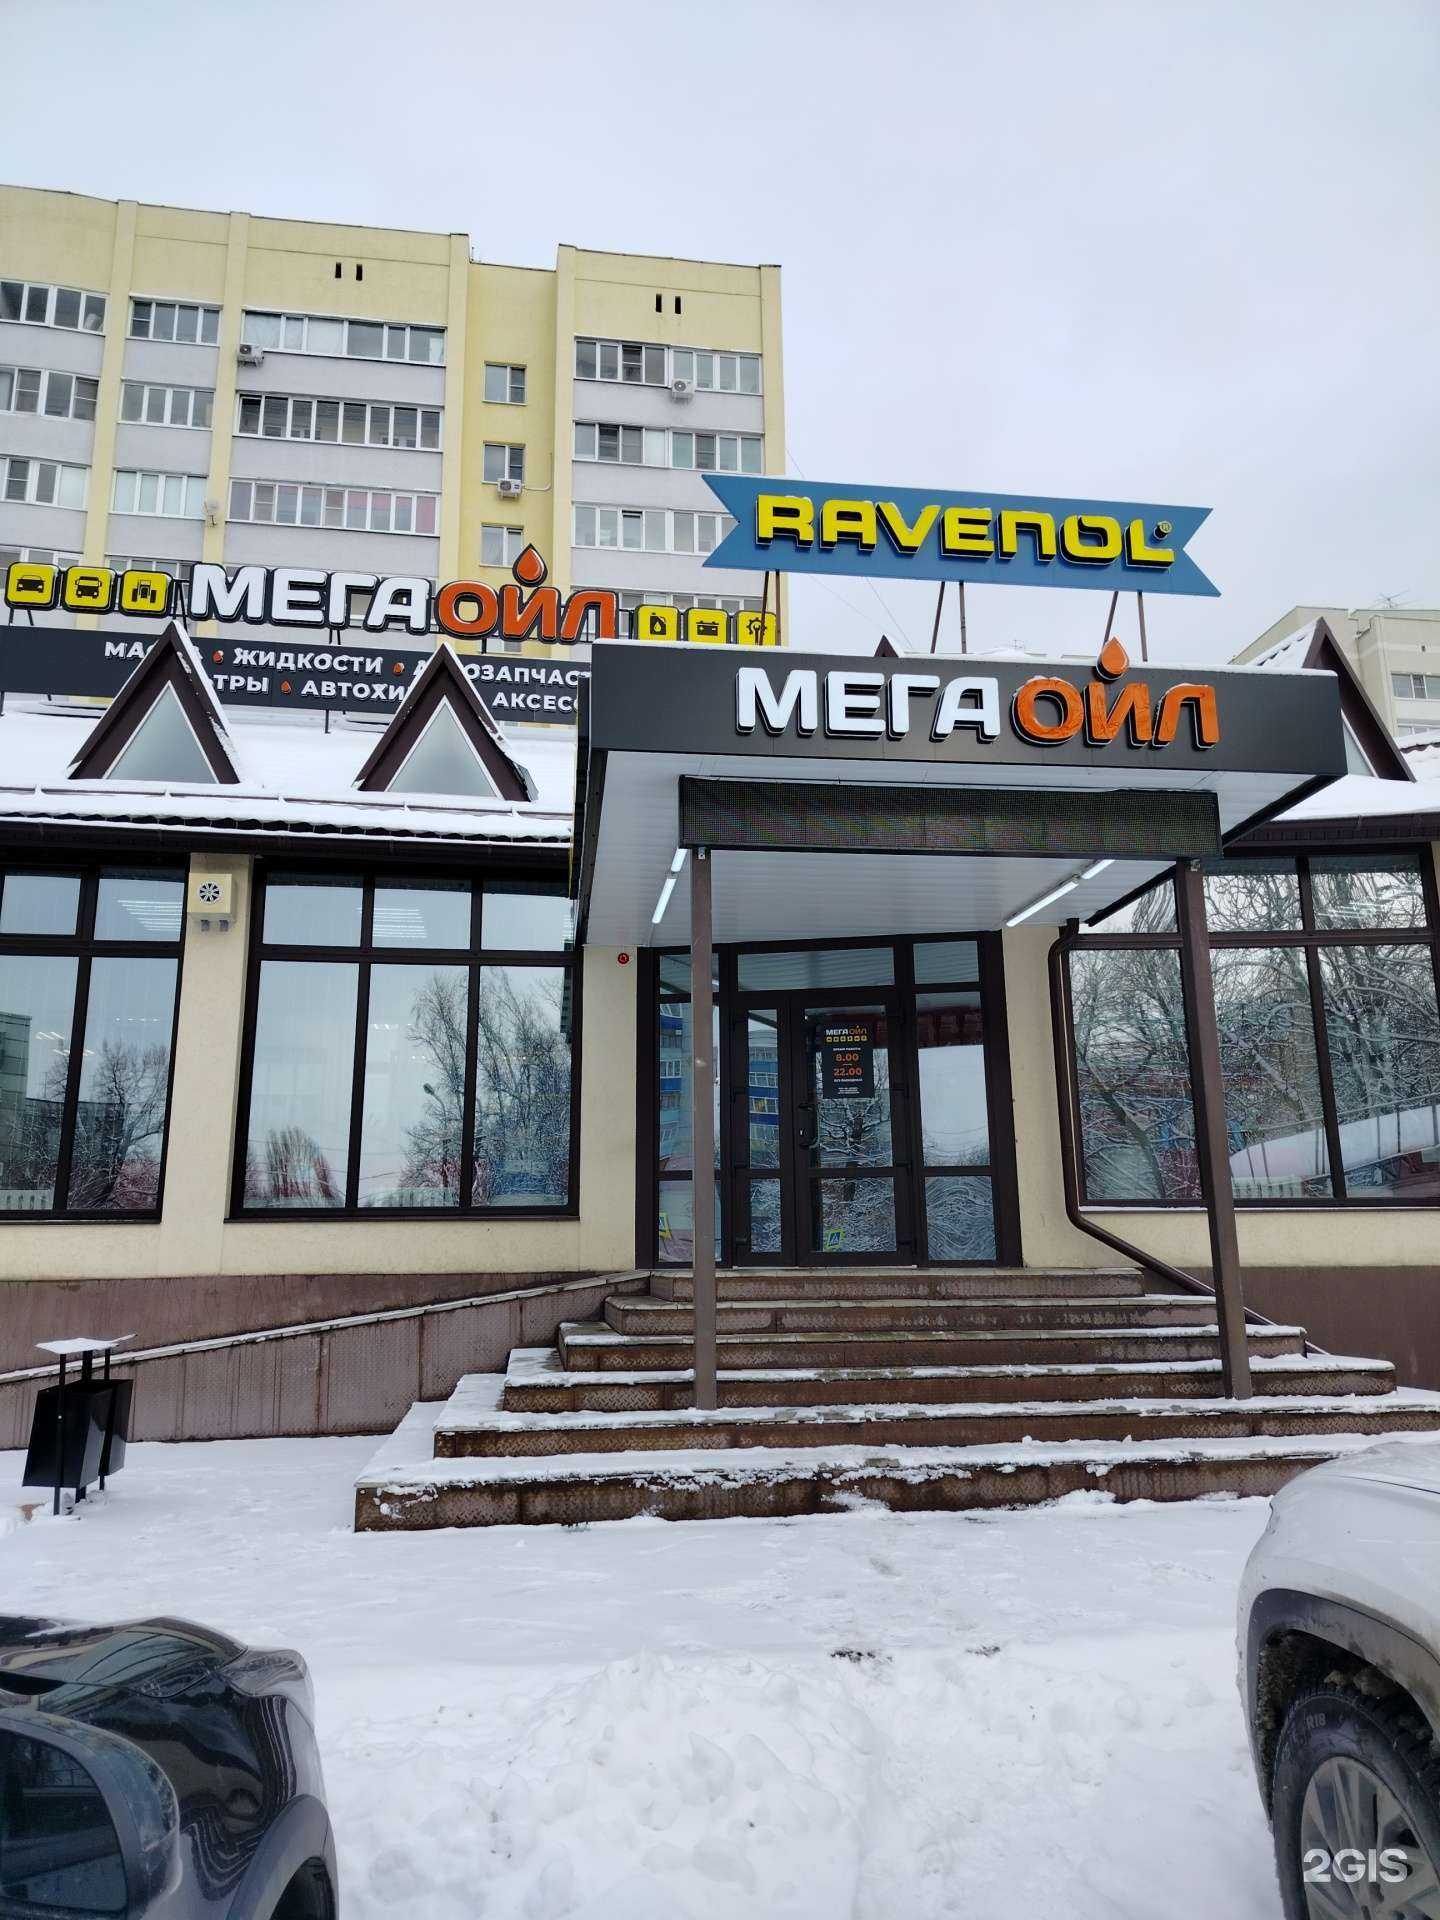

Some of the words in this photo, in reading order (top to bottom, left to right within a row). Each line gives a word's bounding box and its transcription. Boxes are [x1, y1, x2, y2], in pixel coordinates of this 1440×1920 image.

[756, 493, 1174, 569] RAVENOL
[233, 647, 383, 676] ЖИДКОСТИ
[301, 680, 412, 701] АВТОХИ
[735, 637, 1220, 750] МЕГАОЙЛ
[833, 1067, 862, 1076] 22.00
